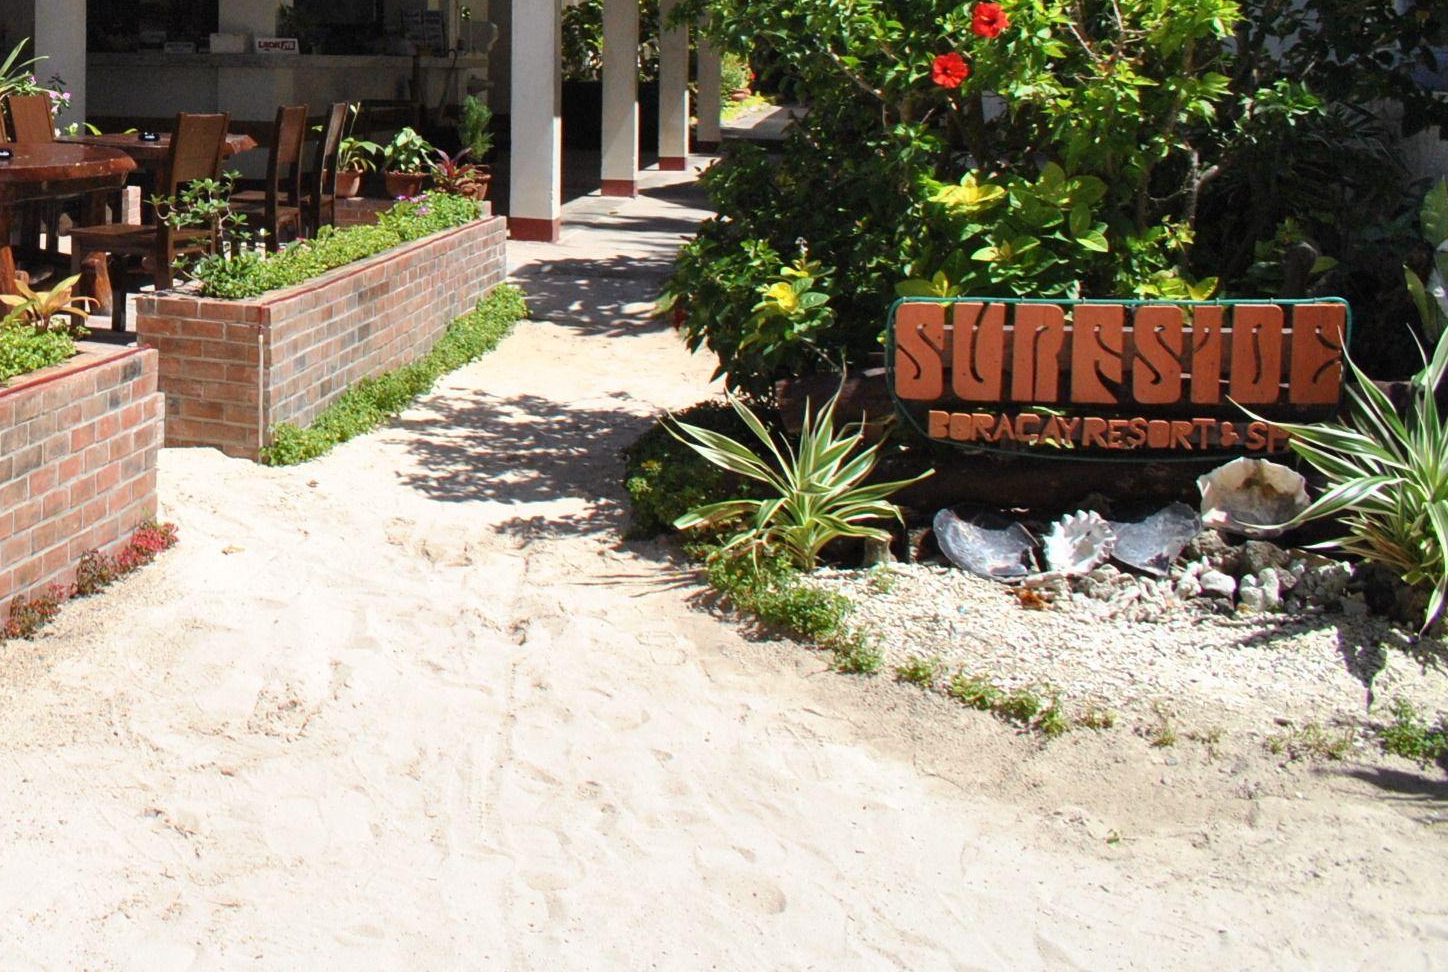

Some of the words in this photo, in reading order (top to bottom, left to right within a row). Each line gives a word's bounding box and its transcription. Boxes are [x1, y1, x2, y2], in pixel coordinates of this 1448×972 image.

[895, 302, 1346, 404] SURFSIDE
[928, 410, 1080, 448] BORACAY
[1083, 416, 1217, 450] RESORT
[1220, 420, 1239, 448] &
[1245, 421, 1304, 454] SP
